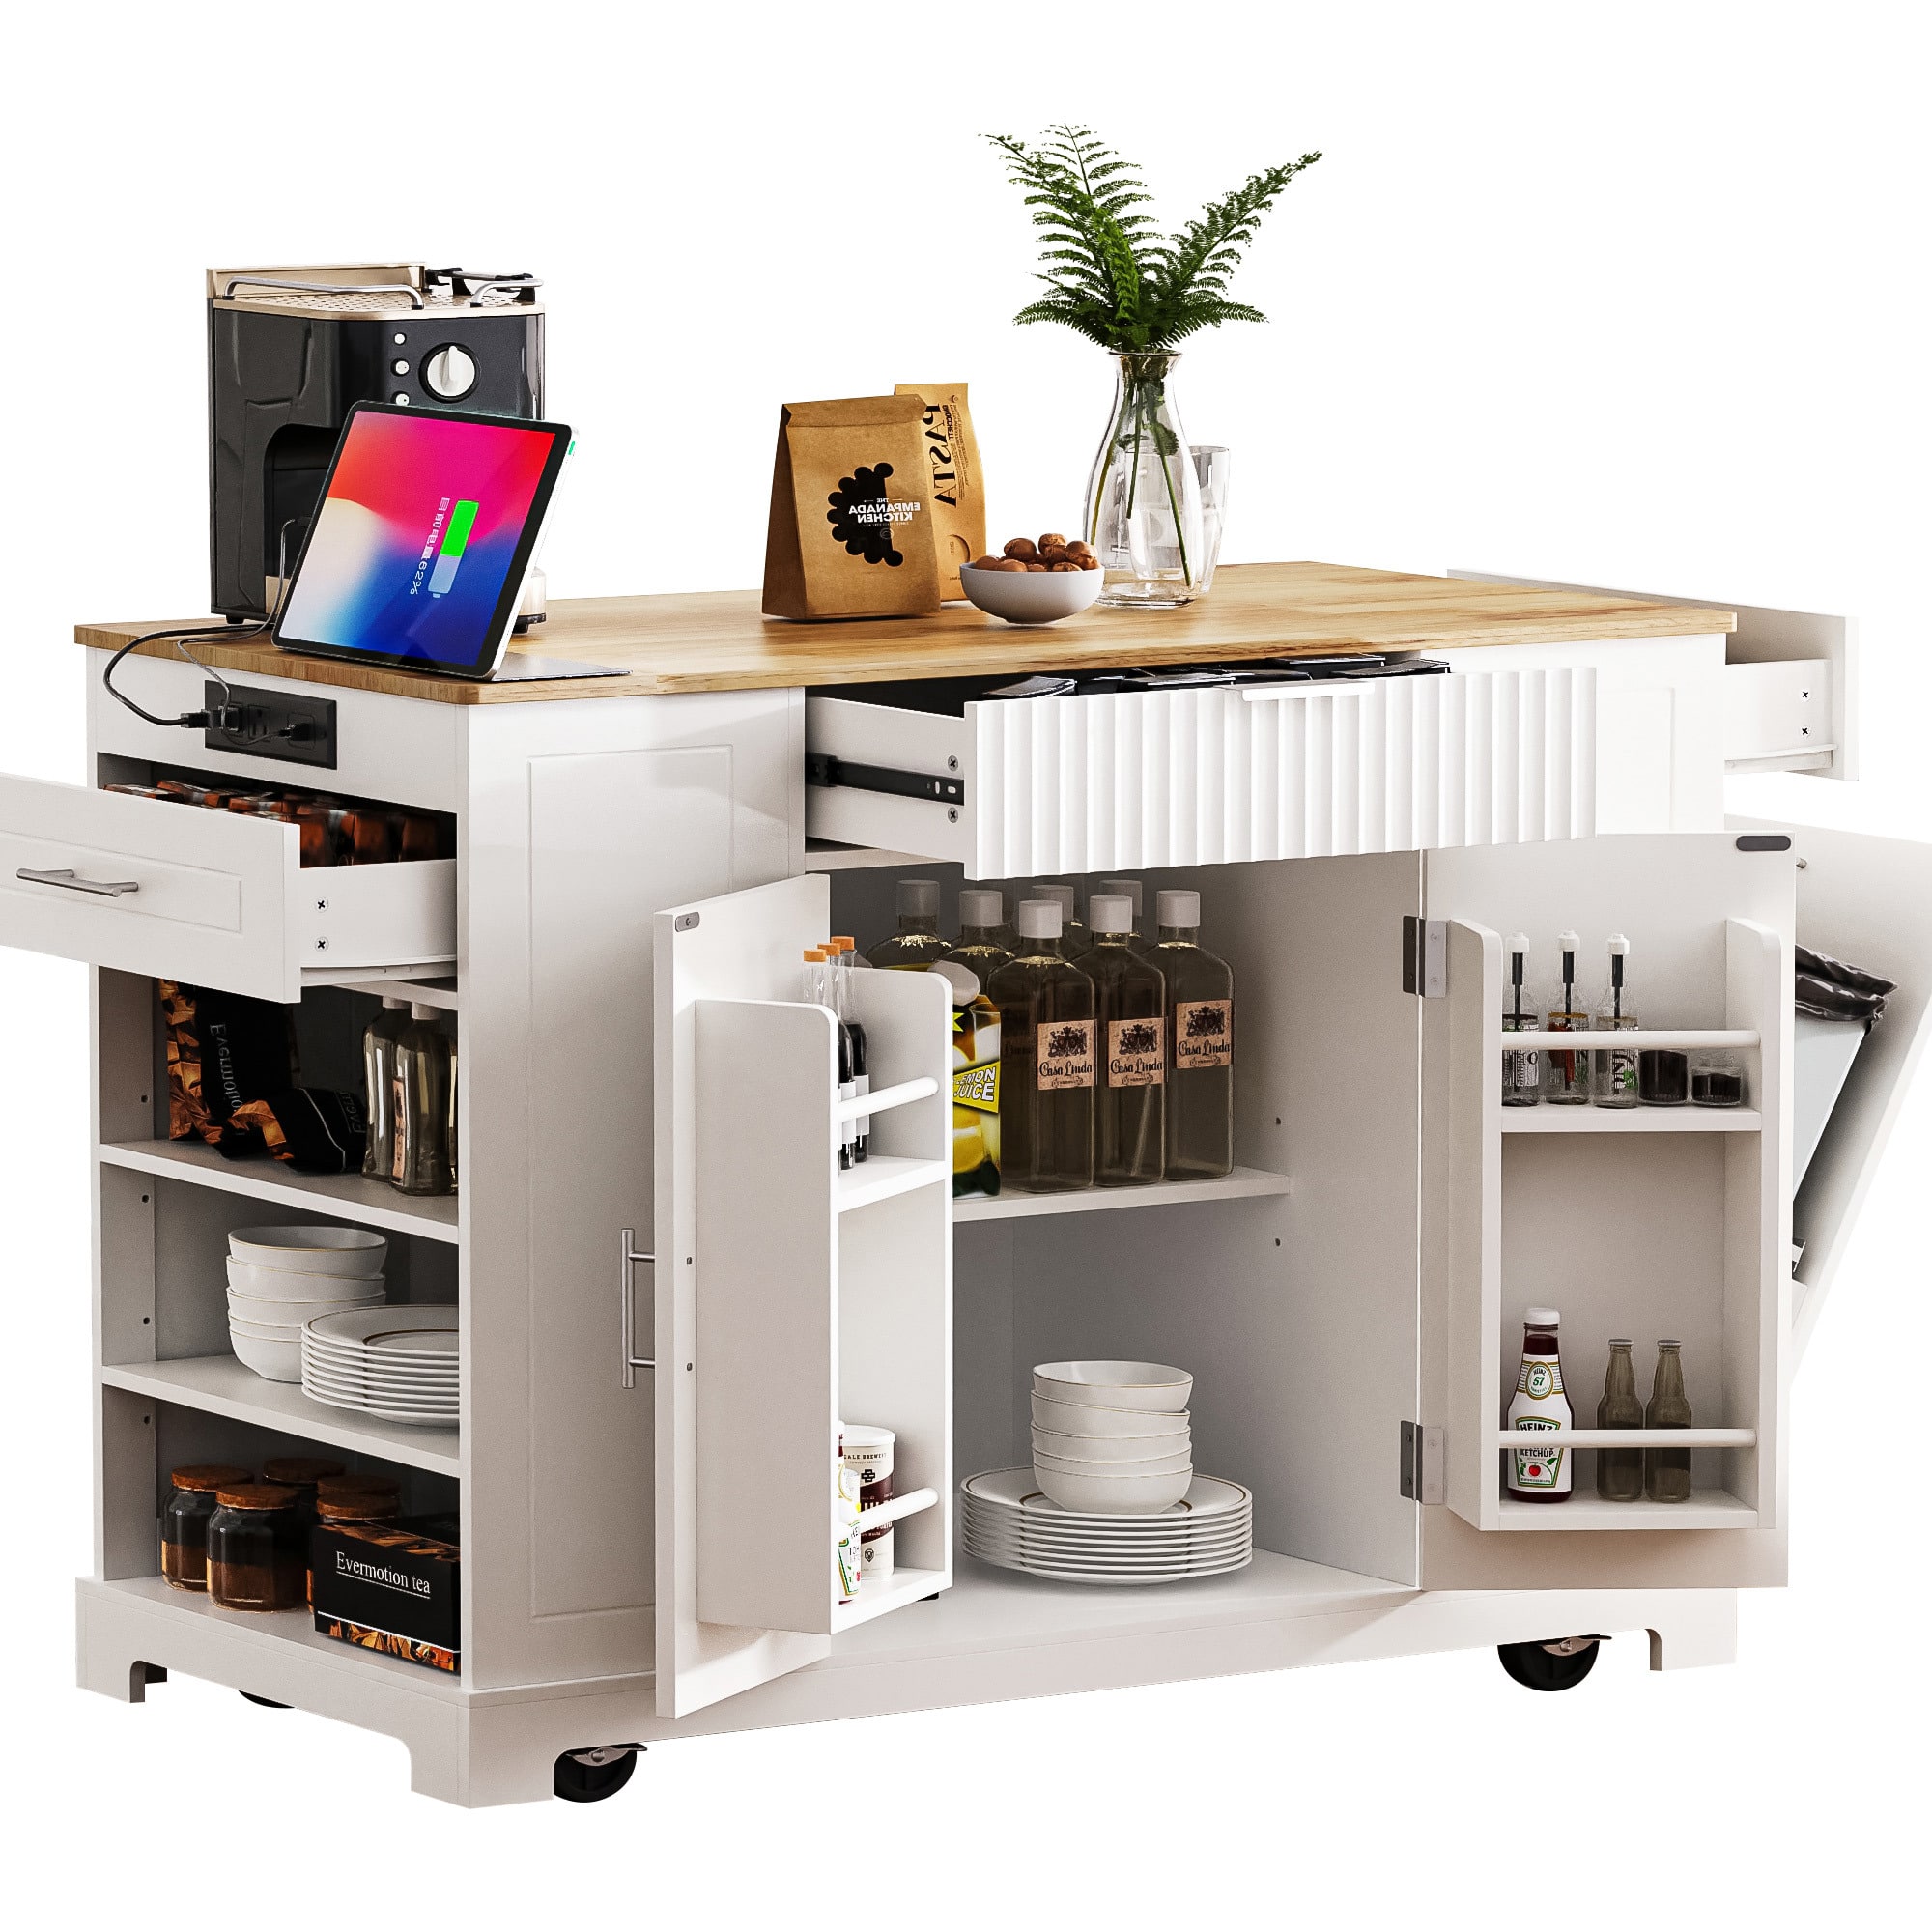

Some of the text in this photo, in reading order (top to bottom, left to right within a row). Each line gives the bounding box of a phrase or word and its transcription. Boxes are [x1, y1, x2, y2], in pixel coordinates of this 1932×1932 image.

[1179, 1039, 1231, 1056] Casa Linda
[1039, 1060, 1093, 1076] Casa Linda
[1111, 1058, 1162, 1074] Casa Linda
[953, 1082, 994, 1101] JUICE
[1533, 1377, 1545, 1385] 57
[1520, 1422, 1553, 1431] HEINZ
[1520, 1449, 1554, 1458] KETCHUP
[336, 1552, 431, 1594] Evermotion tea
